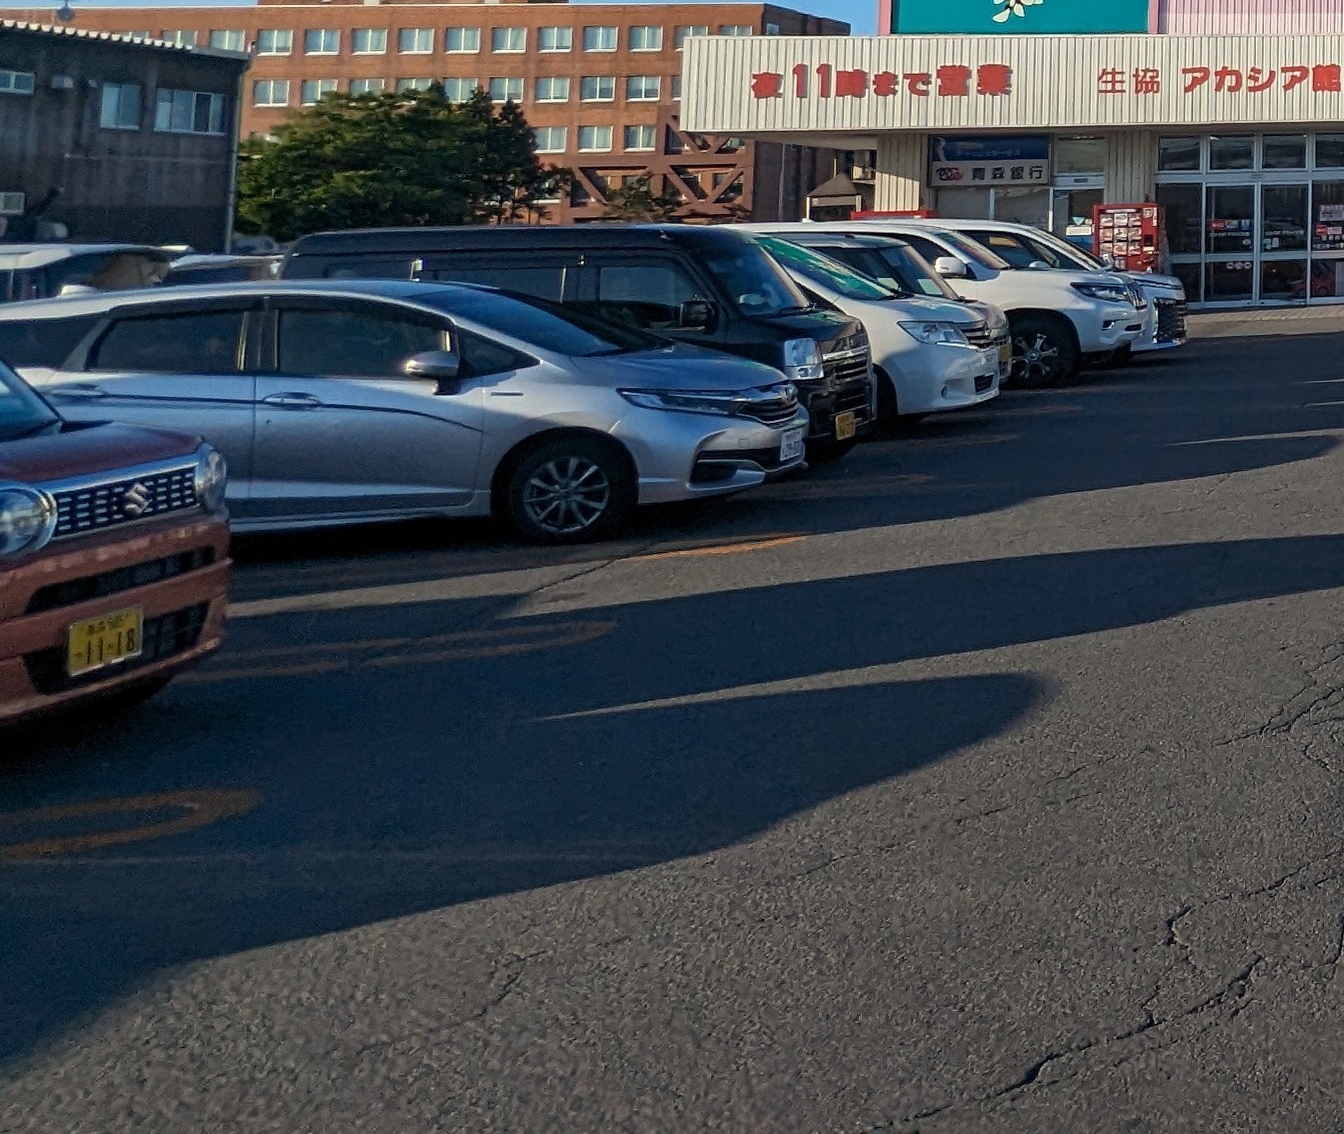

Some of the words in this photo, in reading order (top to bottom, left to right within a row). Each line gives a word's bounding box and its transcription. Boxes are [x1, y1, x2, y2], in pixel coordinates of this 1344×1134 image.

[1098, 67, 1160, 94] 生協
[1182, 64, 1342, 93] アカシア館
